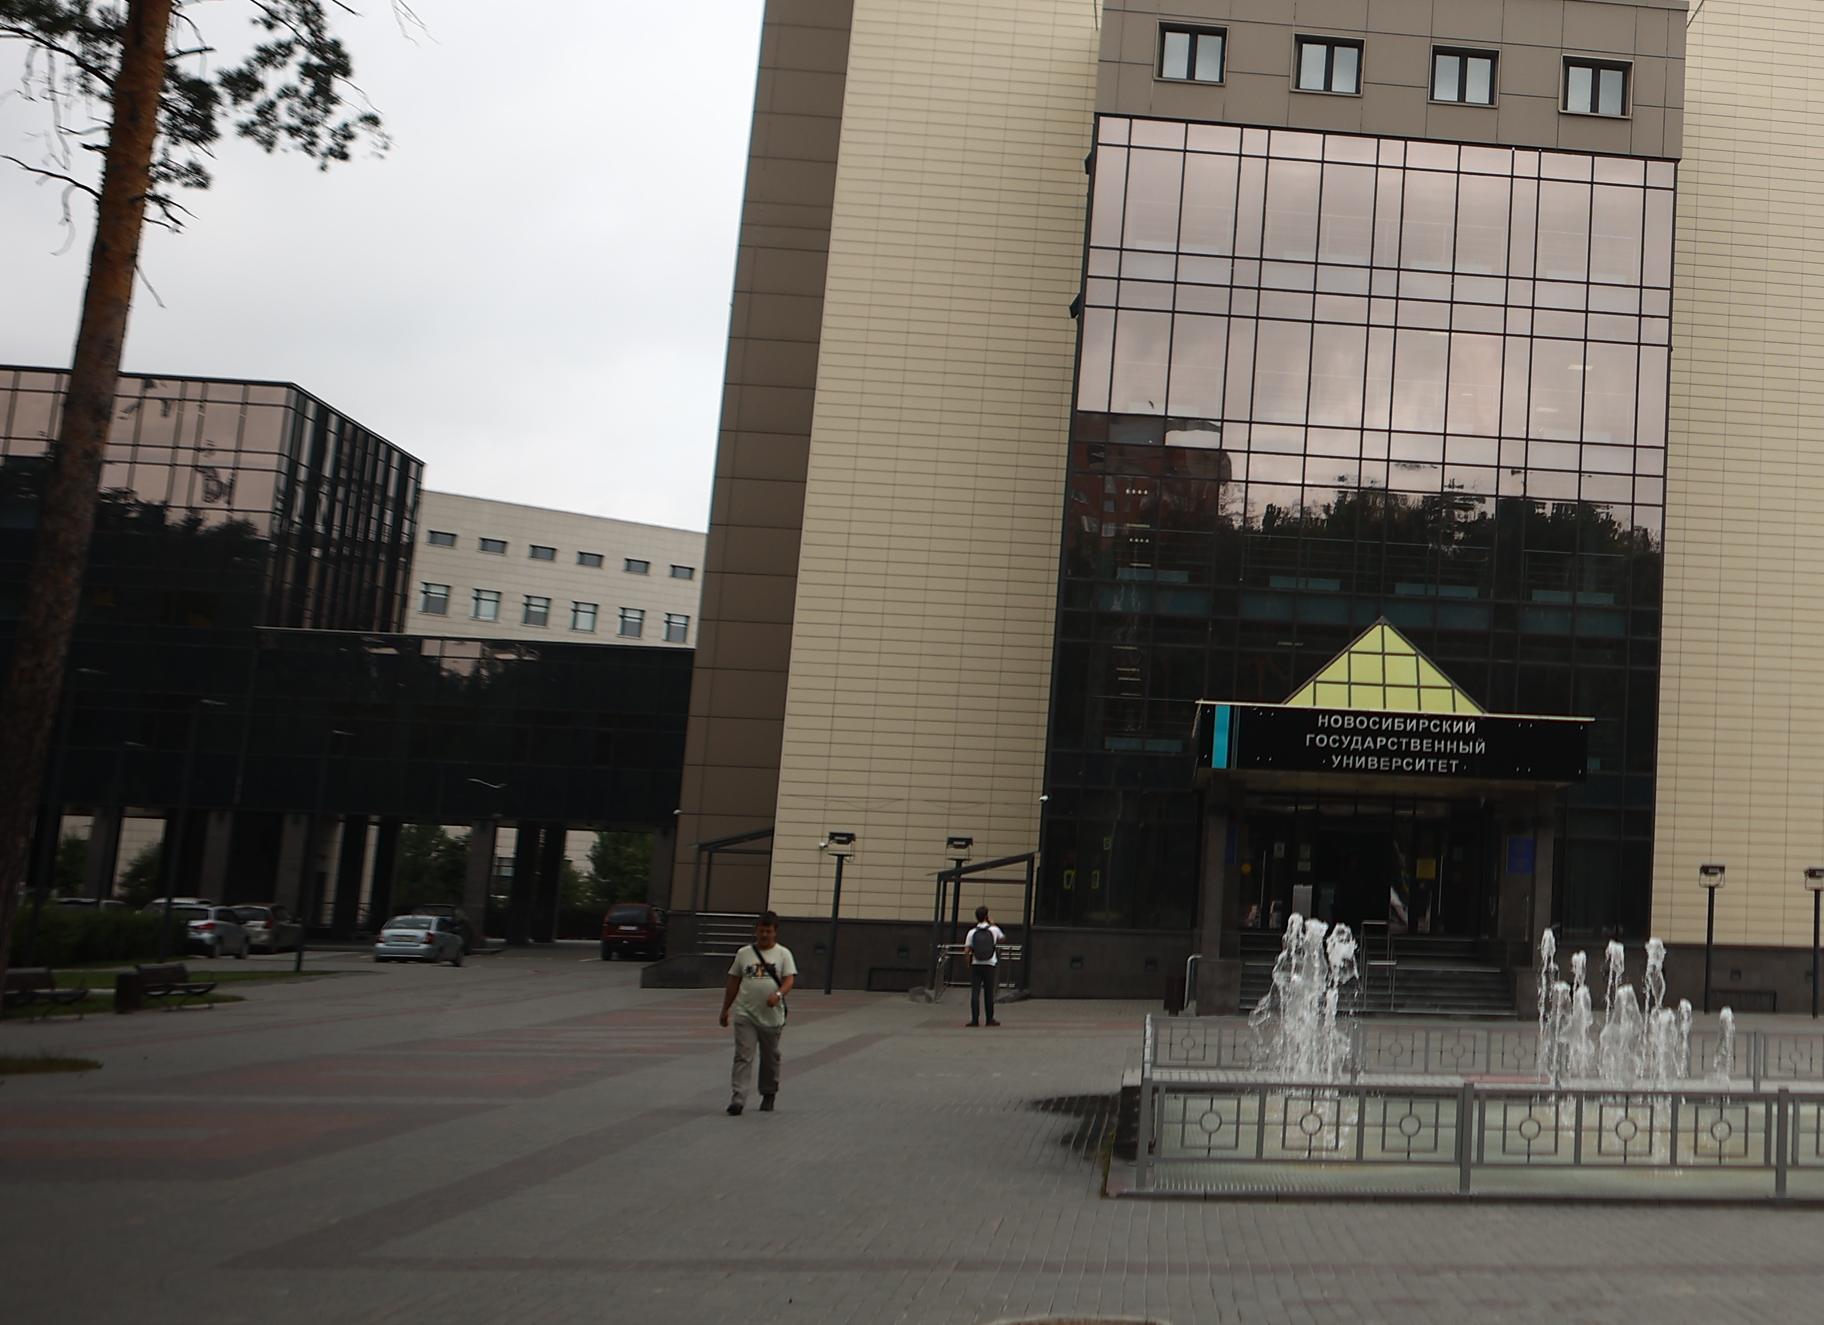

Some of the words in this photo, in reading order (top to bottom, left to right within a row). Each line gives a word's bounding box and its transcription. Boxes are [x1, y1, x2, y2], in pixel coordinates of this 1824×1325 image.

[1317, 714, 1476, 733] НОВОСИБИРСКИЙ
[1305, 734, 1486, 755] ГОСУДАРСТВЕННЫЙ
[1331, 755, 1459, 773] УНИВЕРСИТЕТ
